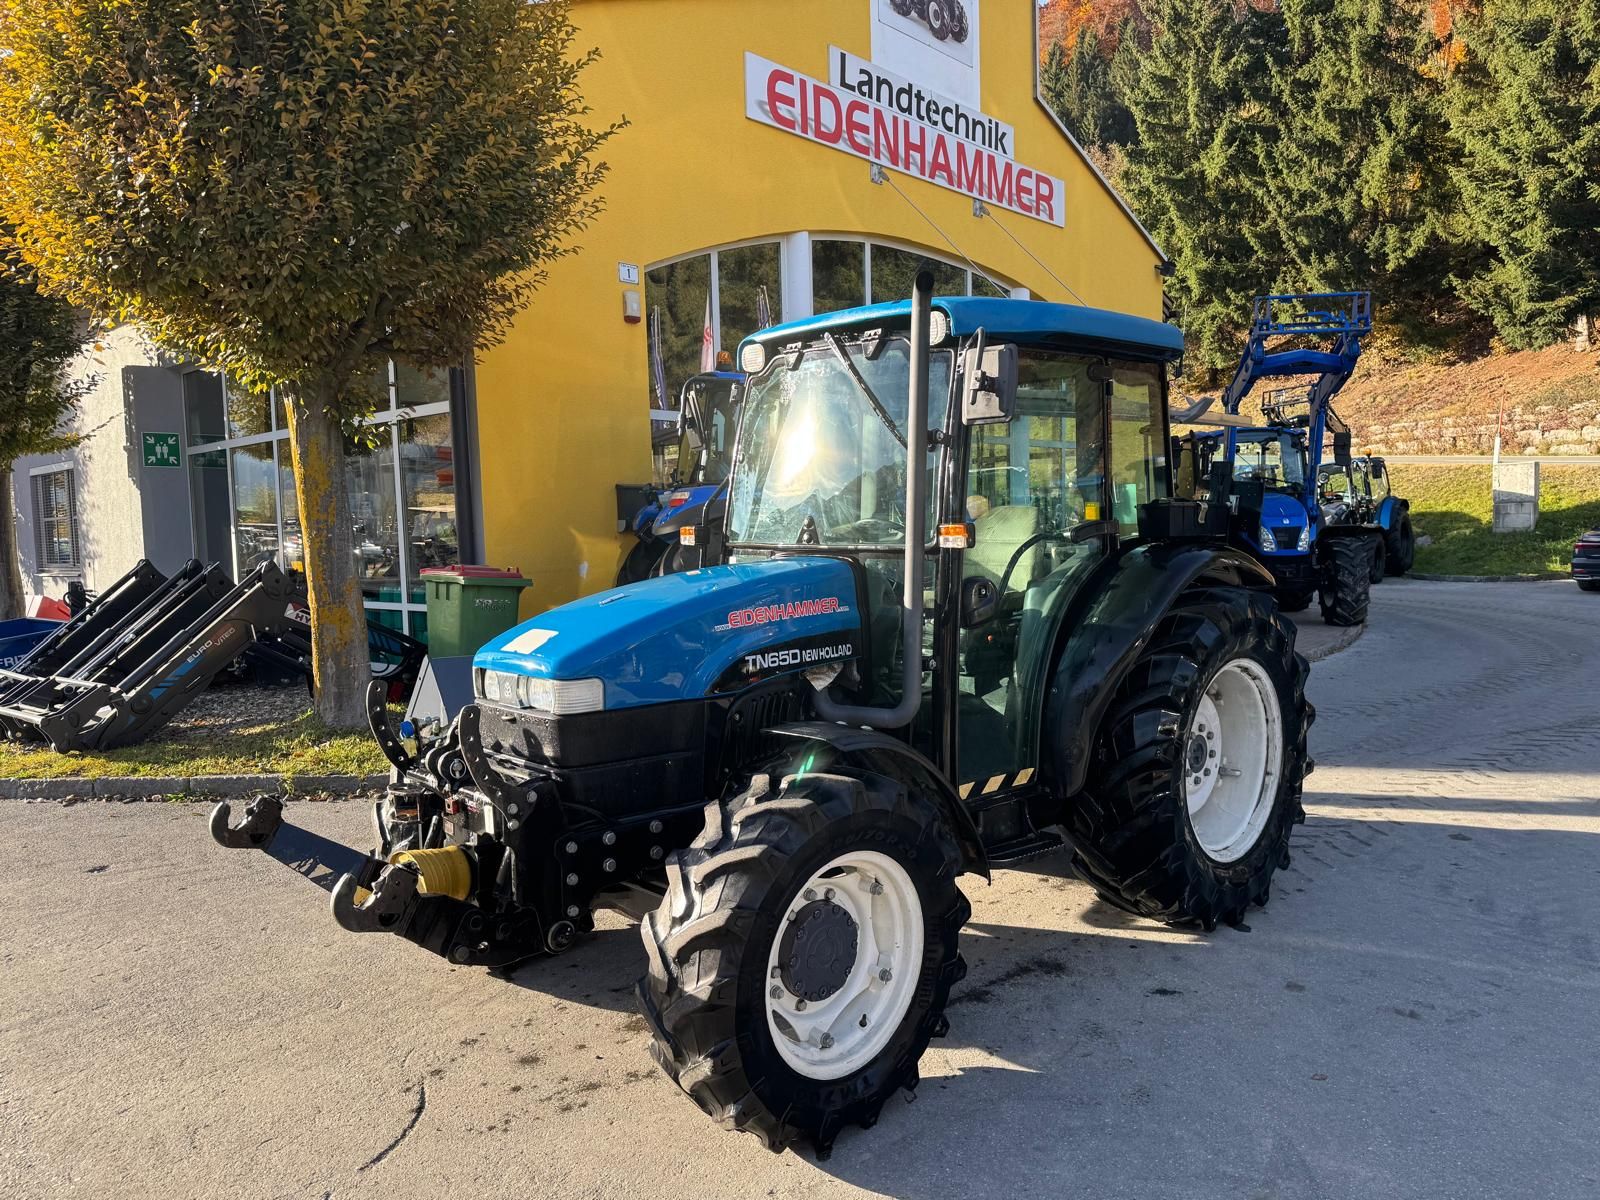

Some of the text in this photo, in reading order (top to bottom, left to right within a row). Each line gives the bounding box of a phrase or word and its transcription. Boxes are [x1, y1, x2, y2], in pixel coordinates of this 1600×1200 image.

[839, 51, 1009, 155] Landtechnik
[766, 69, 1055, 221] EIDENHAMMER
[187, 640, 213, 663] EURO
[745, 645, 852, 669] TN65D NEW HOLLAND
